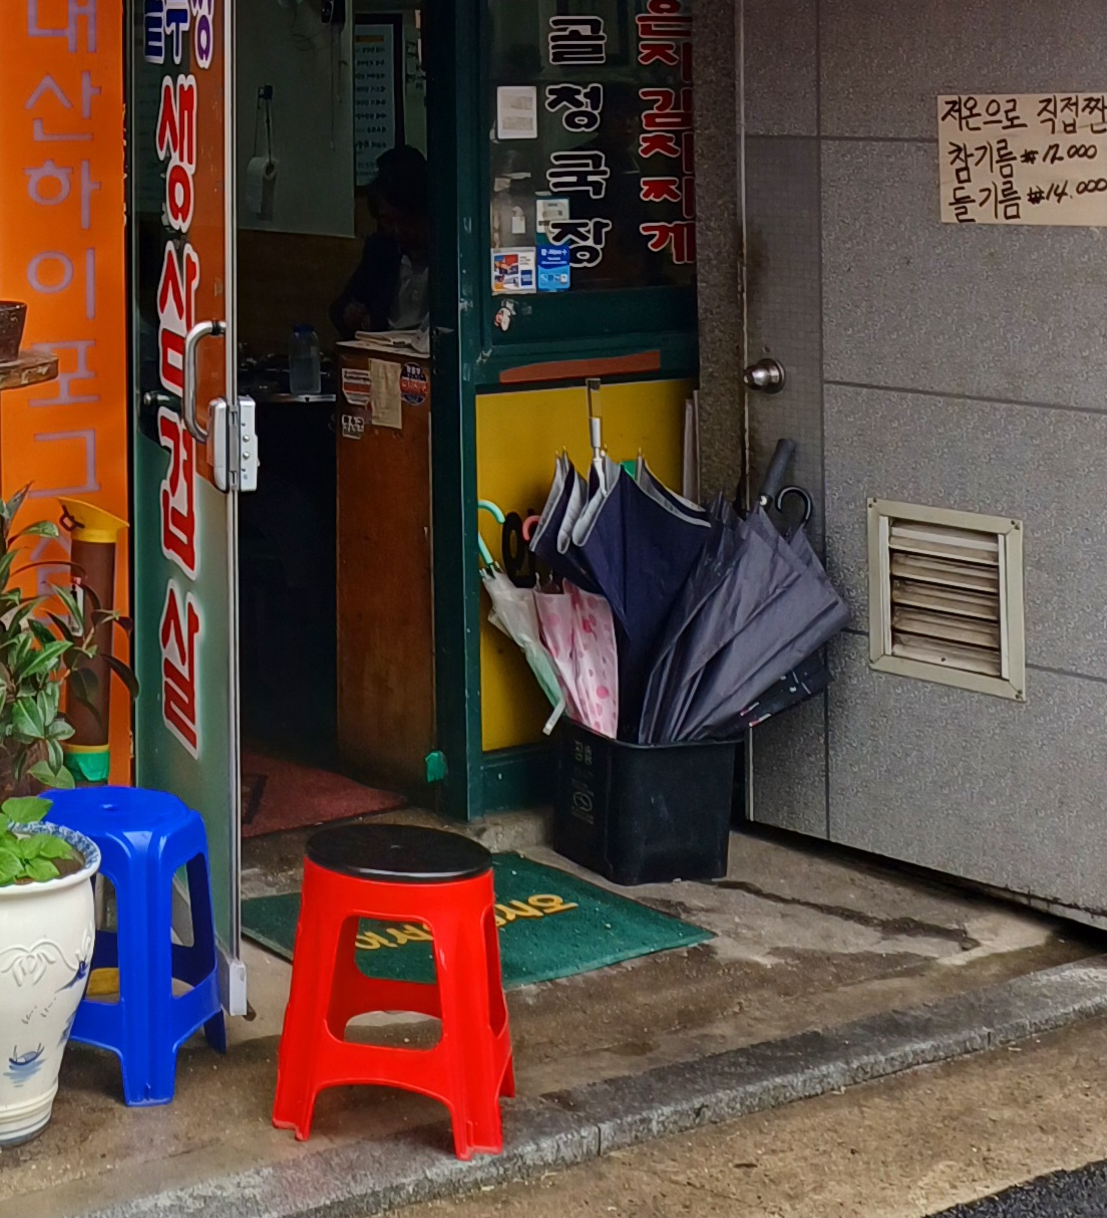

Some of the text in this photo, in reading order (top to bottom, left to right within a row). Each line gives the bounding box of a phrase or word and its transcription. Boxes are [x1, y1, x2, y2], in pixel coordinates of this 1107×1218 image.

[941, 95, 1028, 131] 저온으로
[948, 139, 1022, 184] 참기름
[948, 181, 1022, 223] 들기름
